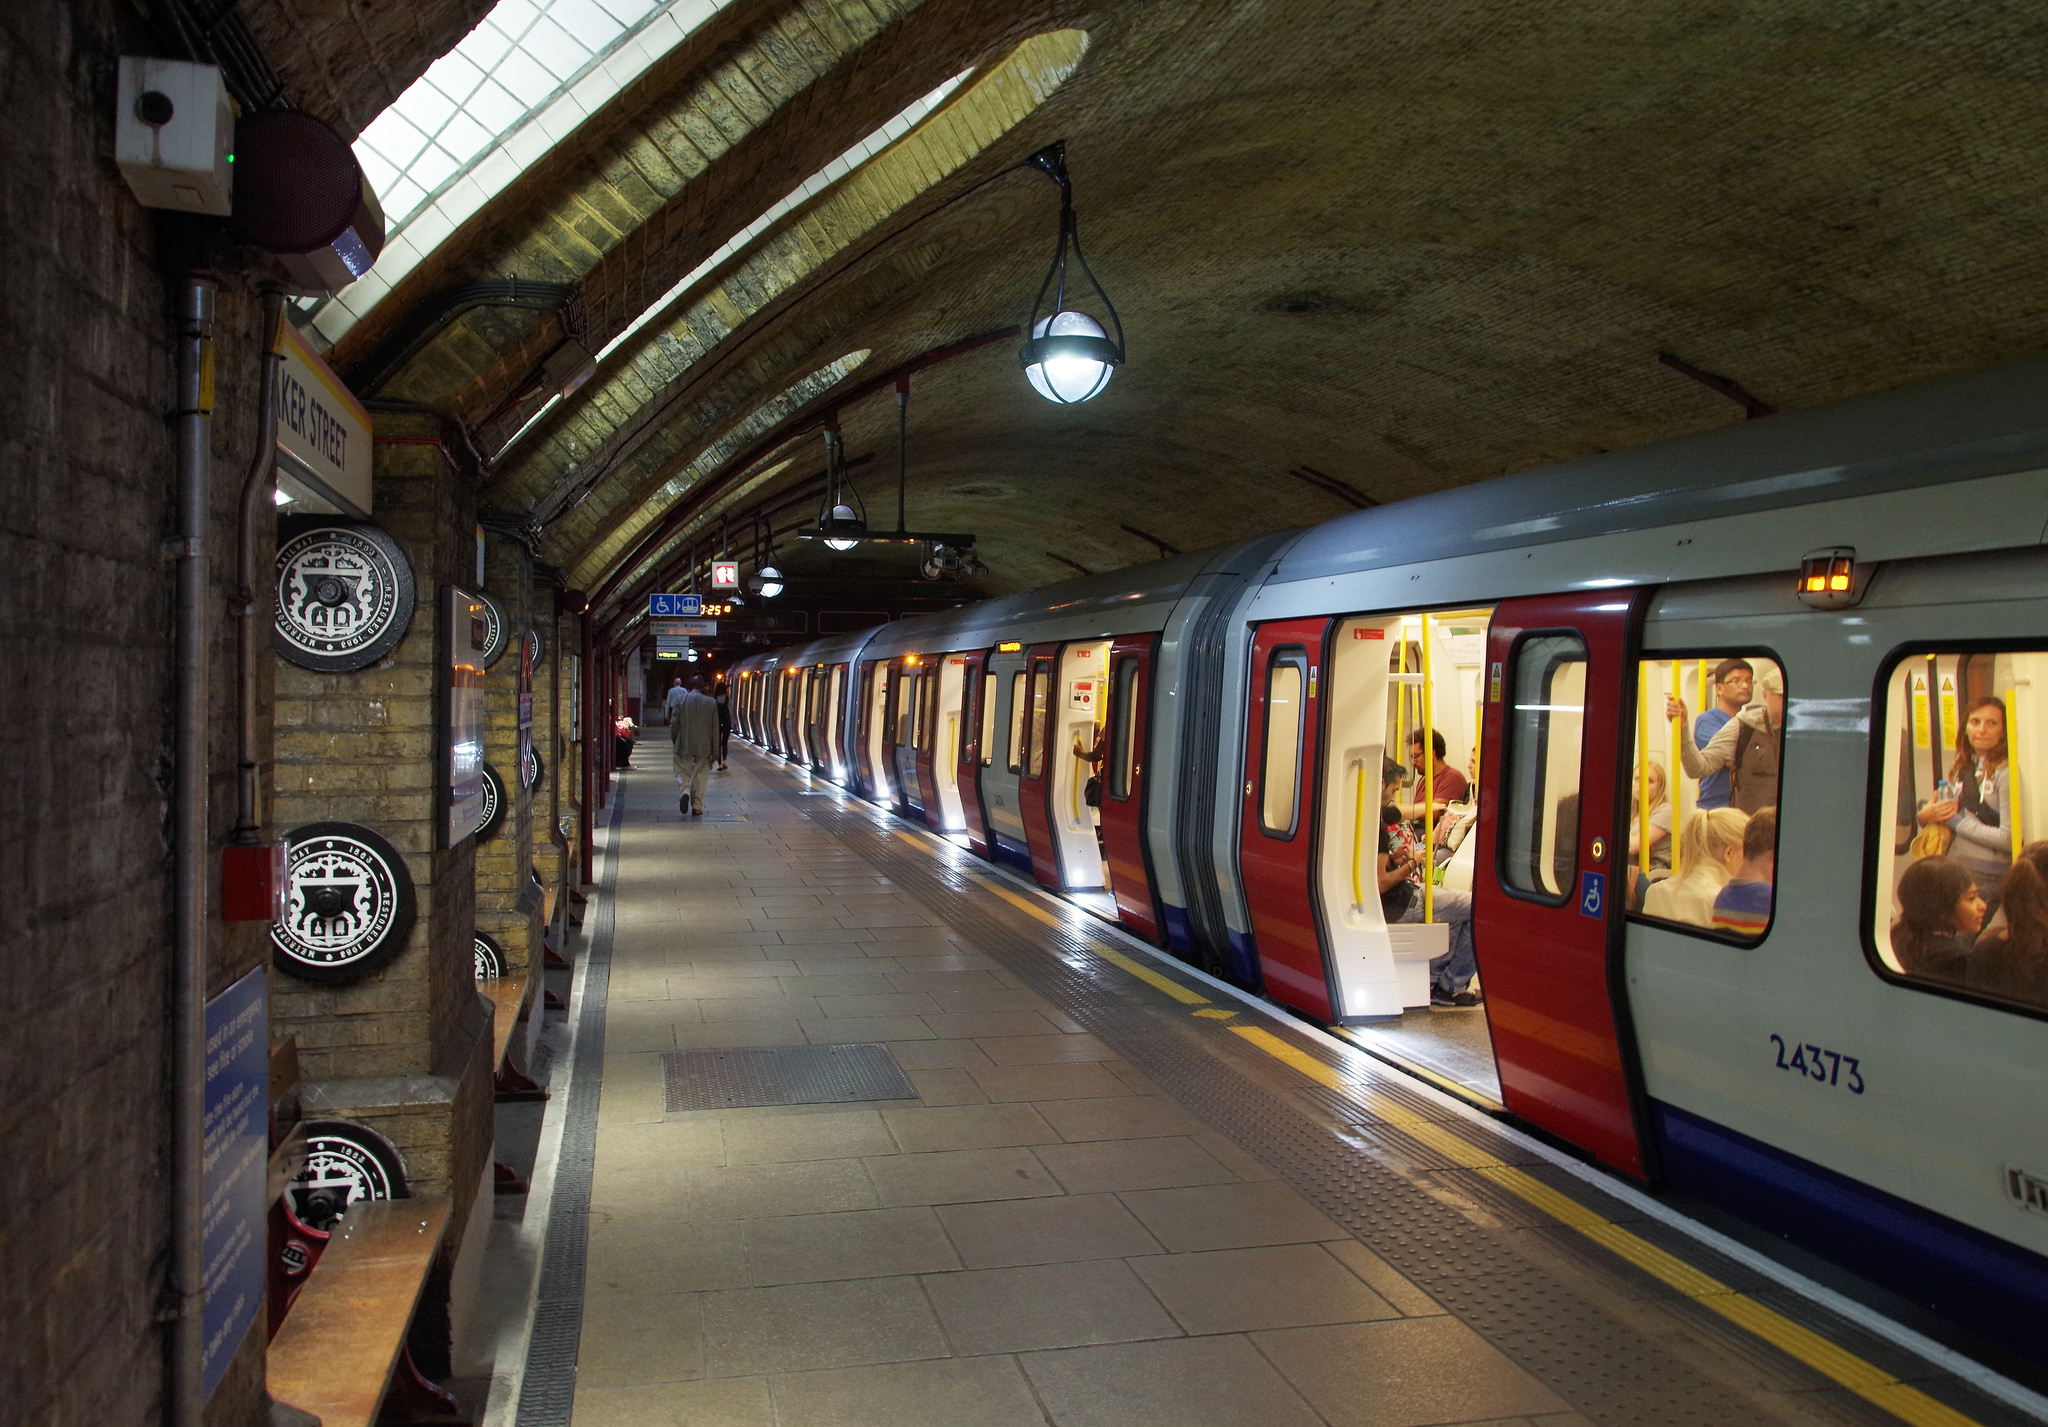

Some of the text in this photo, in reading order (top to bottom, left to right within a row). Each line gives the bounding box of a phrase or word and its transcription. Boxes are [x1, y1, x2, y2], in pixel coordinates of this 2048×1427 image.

[277, 368, 347, 472] KER STREET
[276, 537, 314, 571] RAILWAY
[275, 603, 316, 647] METROPOL
[367, 584, 393, 635] RESTORED
[348, 845, 374, 865] 1863
[366, 892, 391, 943] RESTORED
[207, 996, 263, 1055] used in an emergency
[207, 1028, 254, 1083] see fire or smoke
[1770, 1034, 1865, 1095] 24373
